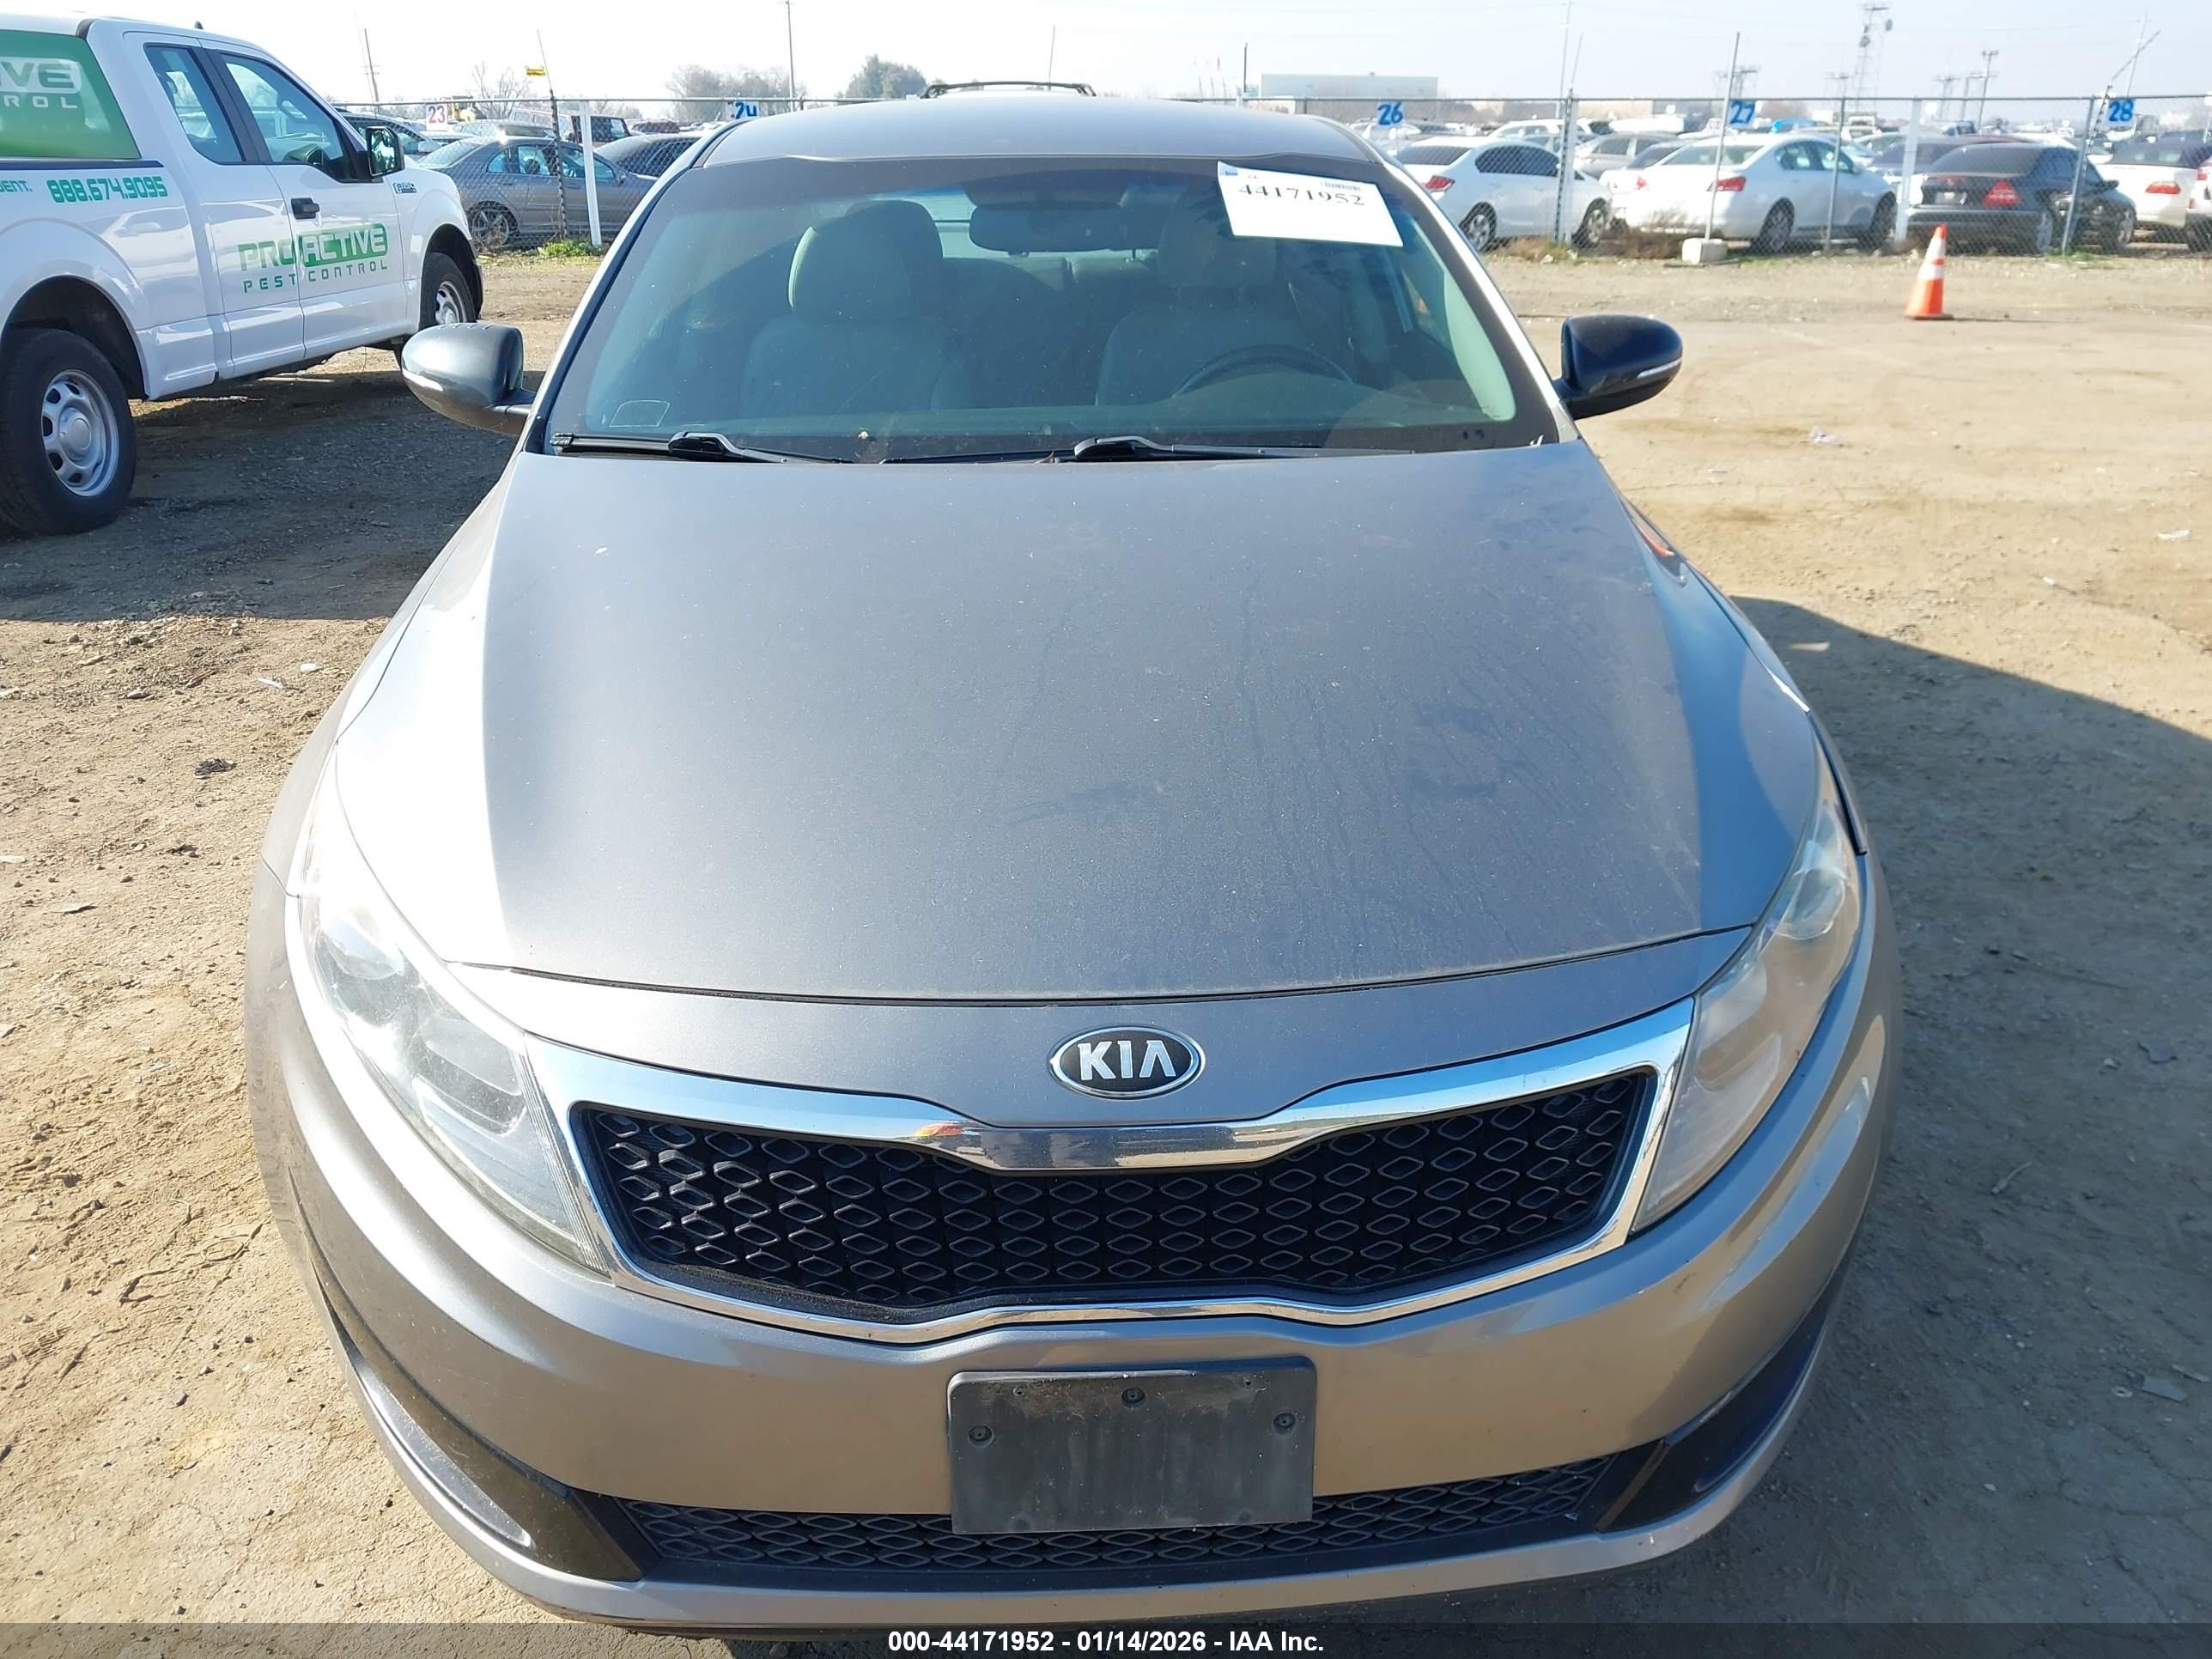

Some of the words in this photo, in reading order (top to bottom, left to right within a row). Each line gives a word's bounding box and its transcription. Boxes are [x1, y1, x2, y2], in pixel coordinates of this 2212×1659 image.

[428, 105, 446, 123] 23
[1377, 101, 1403, 125] 26
[1730, 100, 1755, 125] 27
[2108, 98, 2134, 121] 28
[46, 176, 168, 203] 888.674.9095
[1239, 184, 1365, 206] 44171952
[243, 273, 296, 293] PEST
[308, 260, 388, 283] CONTROL
[1078, 1040, 1177, 1080] KIA
